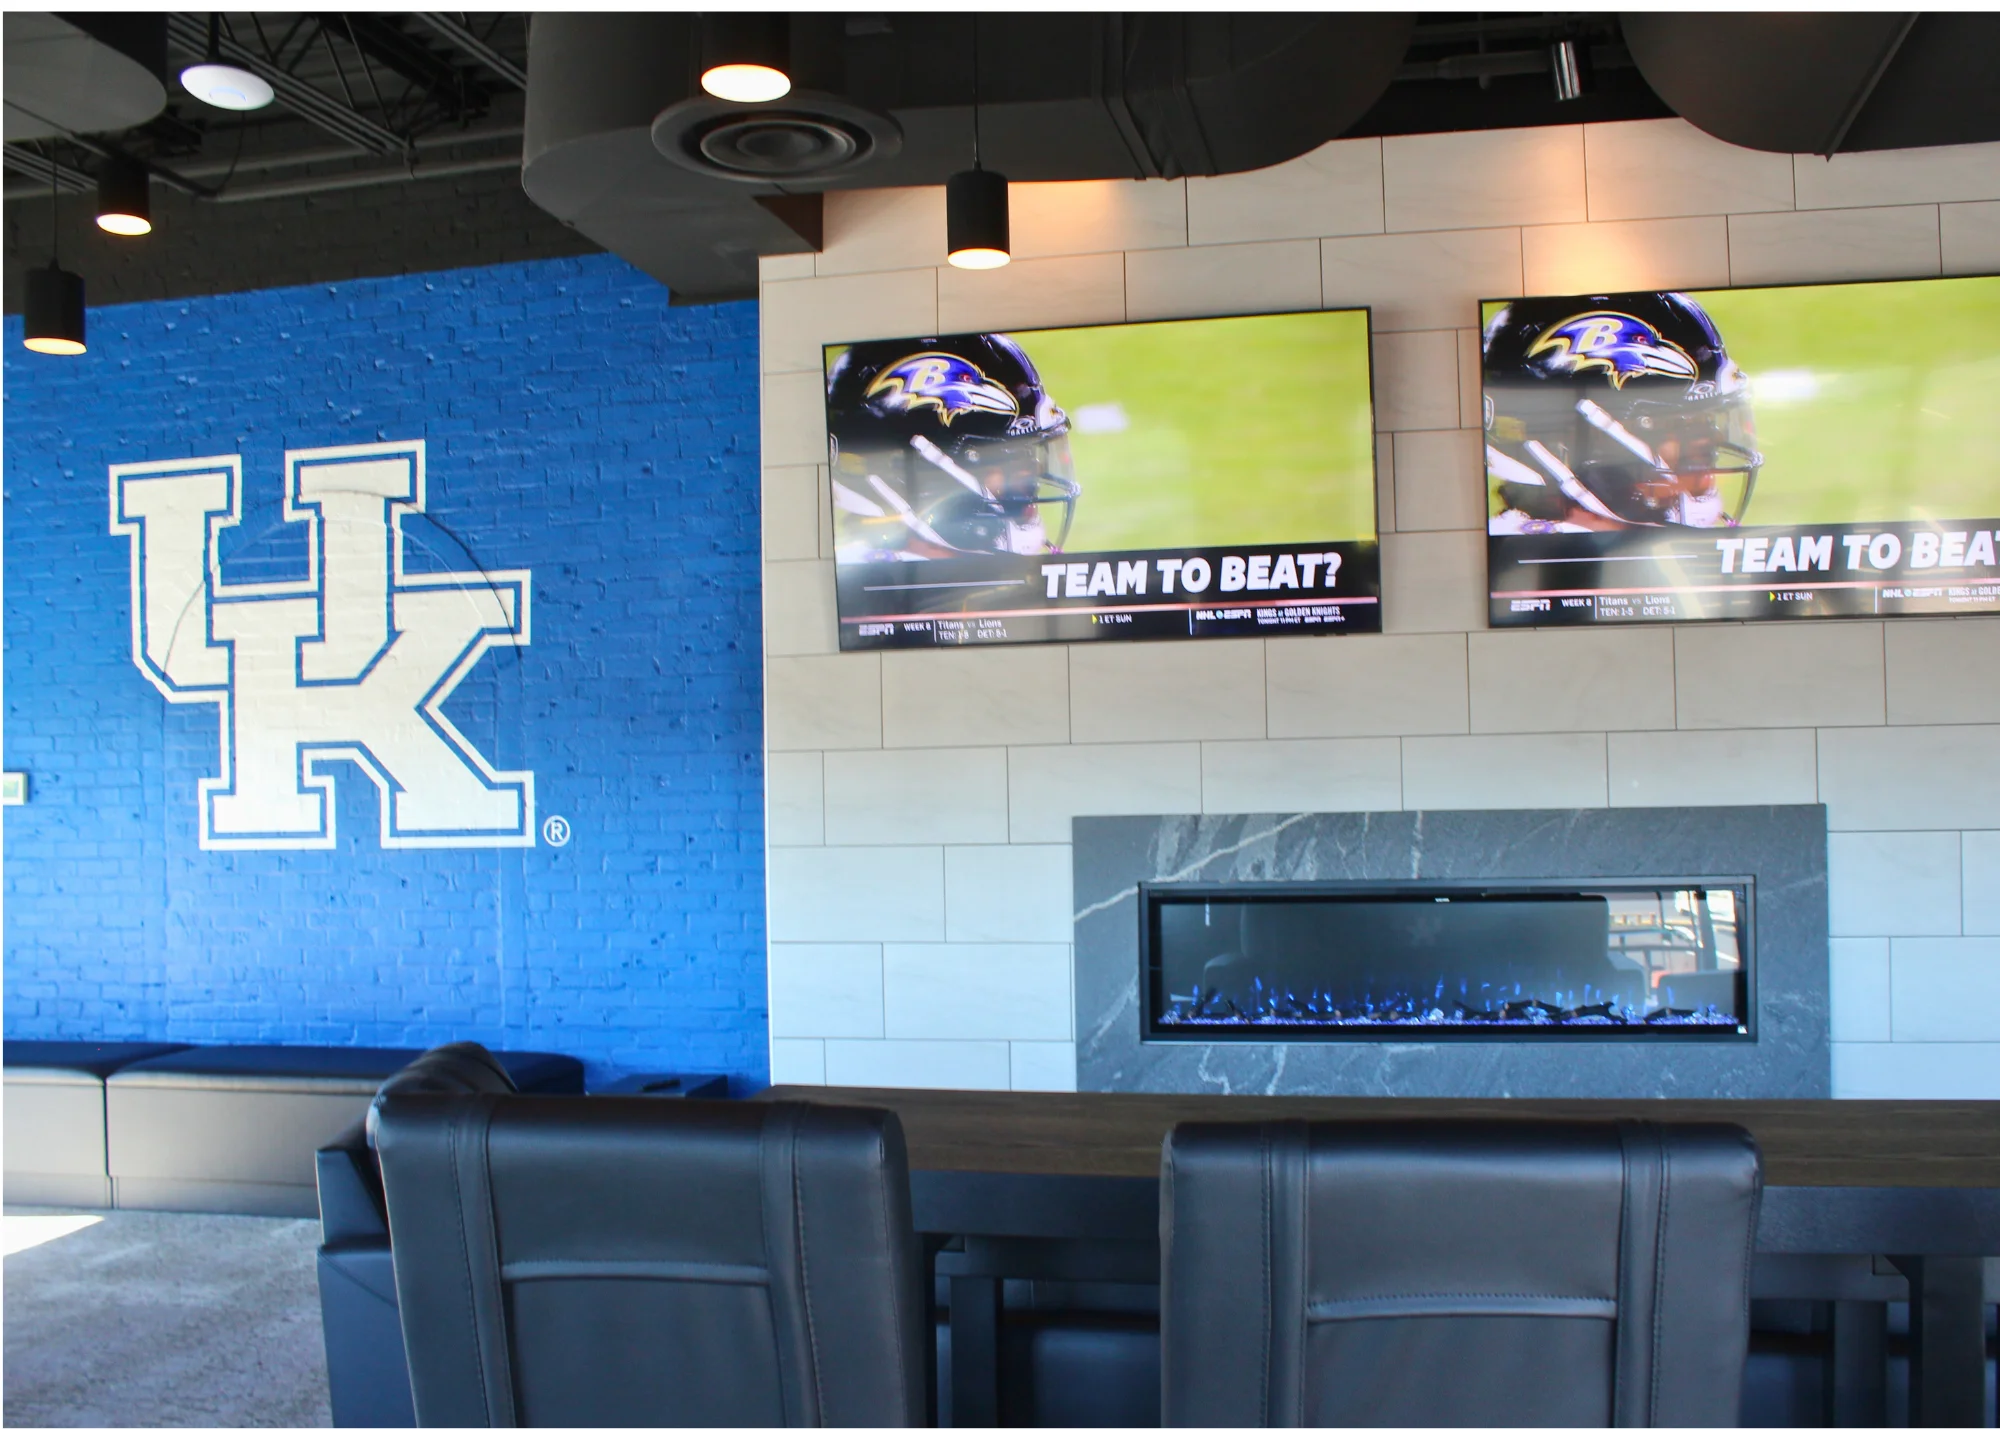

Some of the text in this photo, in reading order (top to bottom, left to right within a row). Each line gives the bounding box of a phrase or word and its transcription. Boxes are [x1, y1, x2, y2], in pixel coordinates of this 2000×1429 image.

[1716, 530, 2000, 574] TEAM TO BEA
[1041, 552, 1343, 598] TEAM TO BEAT?
[1794, 591, 1814, 601] SUN
[1882, 588, 1905, 599] NHL
[1510, 598, 1551, 613] ESPN
[1561, 598, 1586, 608] WEEK
[1599, 594, 1671, 607] Titans vs Lions
[1195, 609, 1217, 621] NHL
[1256, 607, 1278, 618] KINGS
[1284, 606, 1311, 617] GOLDEN
[1311, 605, 1341, 616] KNIGHTS
[938, 619, 965, 631] Titans
[979, 618, 1003, 630] Lions
[1115, 613, 1133, 624] SUN
[858, 622, 895, 637] ESPN
[903, 621, 926, 632] WEEK
[109, 439, 535, 849] UK
